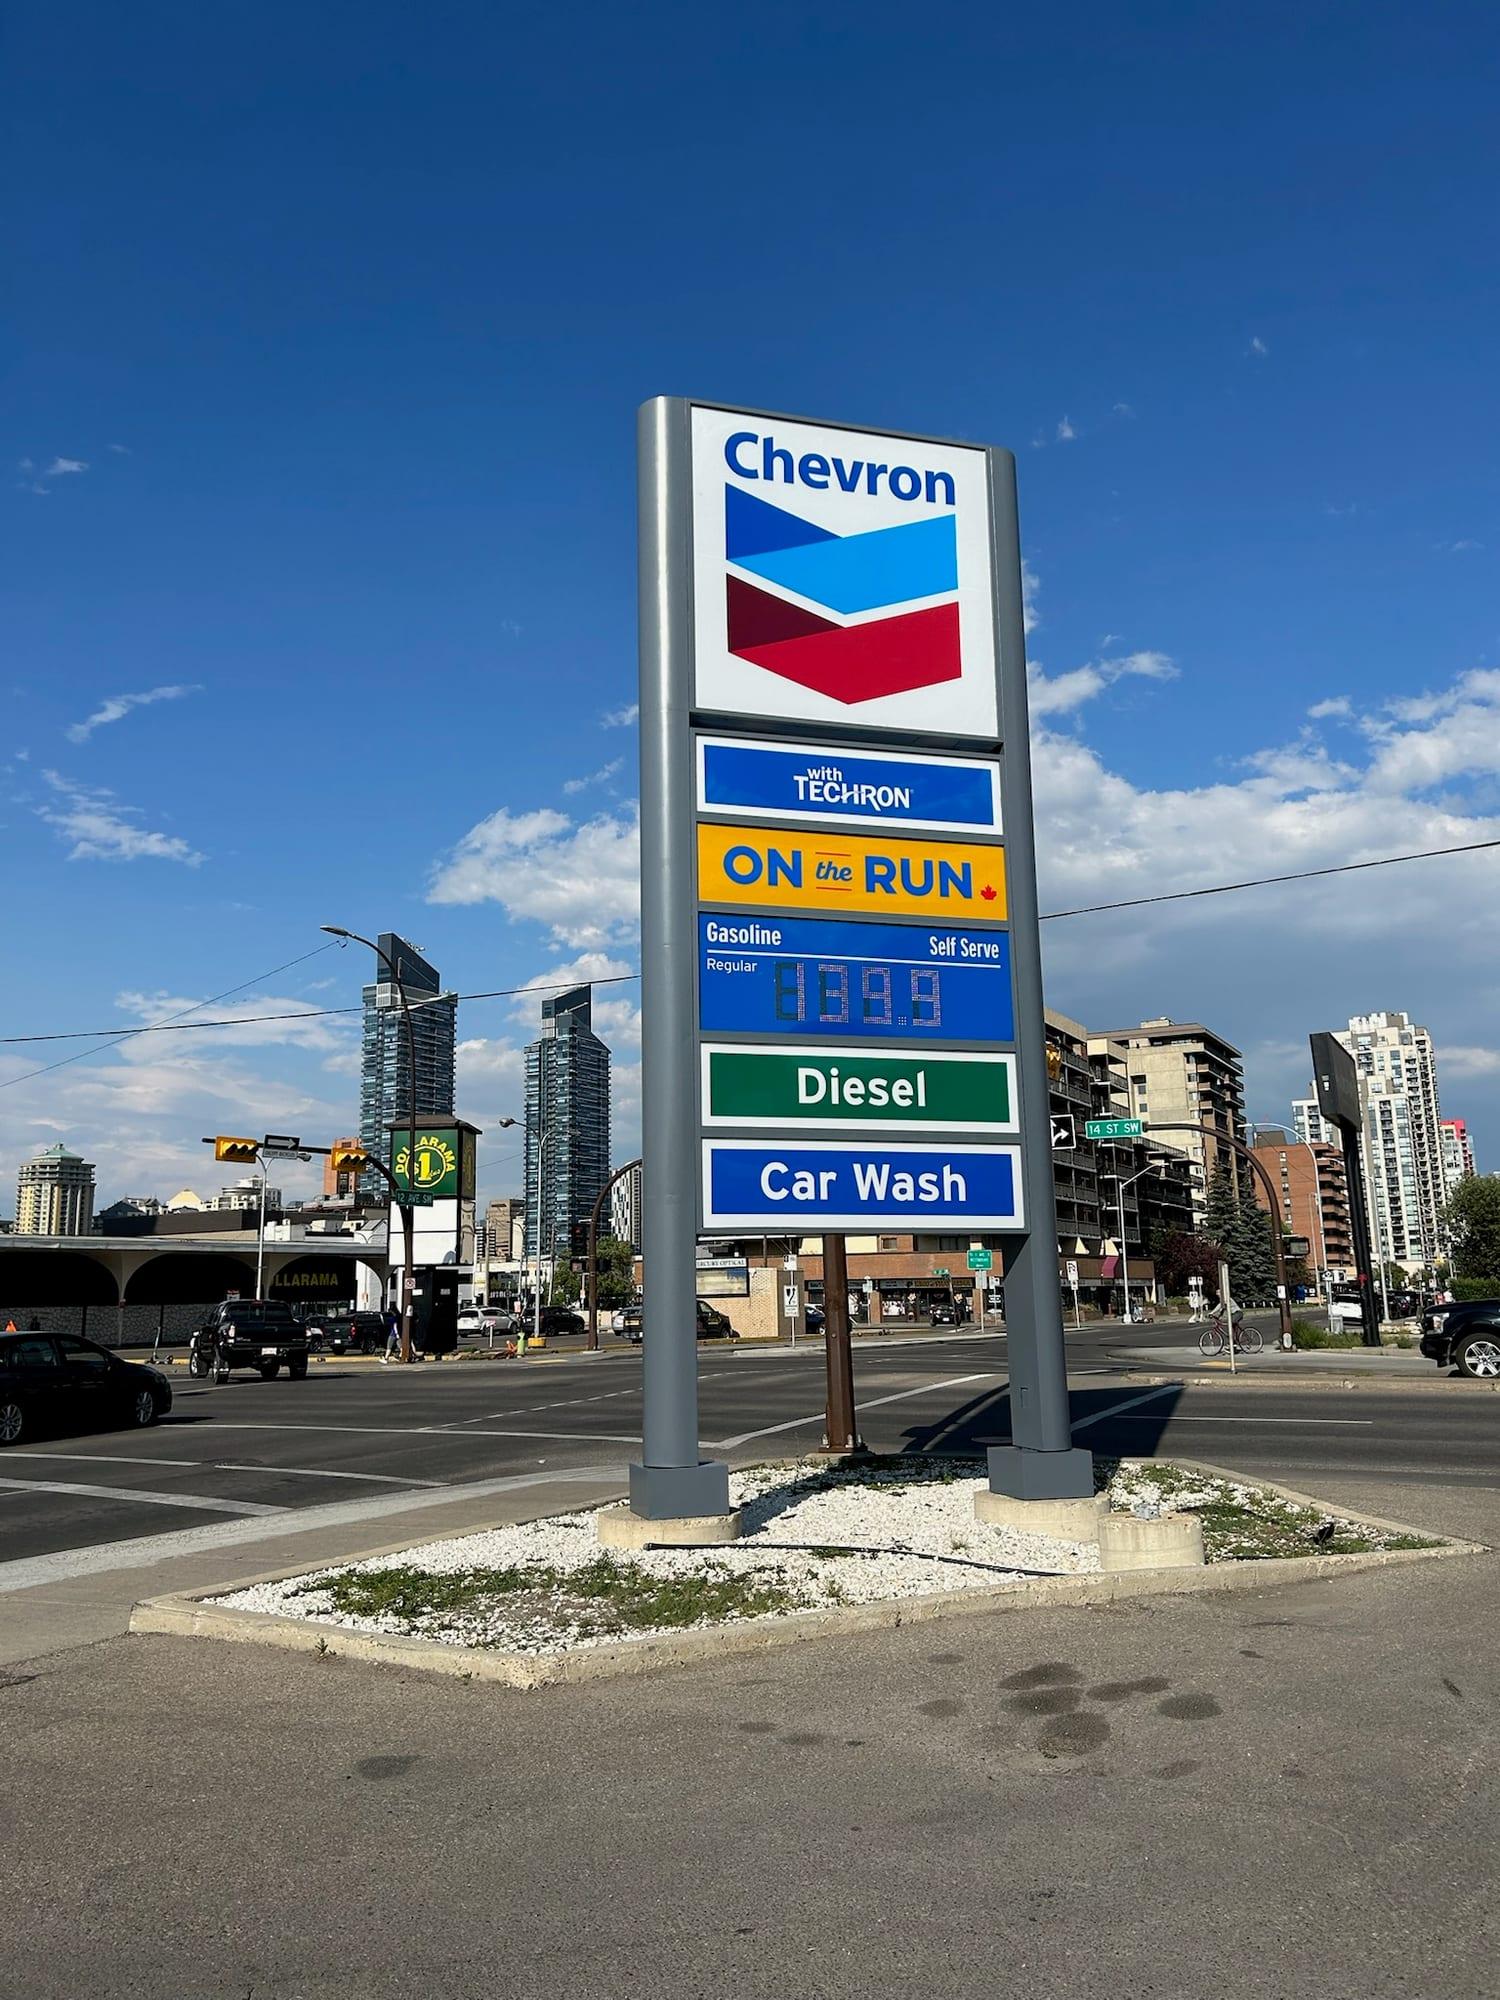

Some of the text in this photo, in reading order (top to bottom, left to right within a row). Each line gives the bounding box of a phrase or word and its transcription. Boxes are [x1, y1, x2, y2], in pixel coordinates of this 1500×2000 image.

[724, 431, 956, 506] Chevron
[807, 767, 842, 782] with
[793, 775, 911, 811] TECHRON
[723, 845, 973, 900] ON the RUN
[706, 921, 782, 947] Gasoline
[929, 936, 1000, 959] Self Serve
[706, 958, 758, 975] Regular
[798, 1067, 926, 1107] Diesel
[1089, 1122, 1139, 1135] 14 ST SW
[760, 1162, 967, 1201] Car Wash
[397, 1192, 405, 1202] 12
[271, 1273, 339, 1287] LLARAMA
